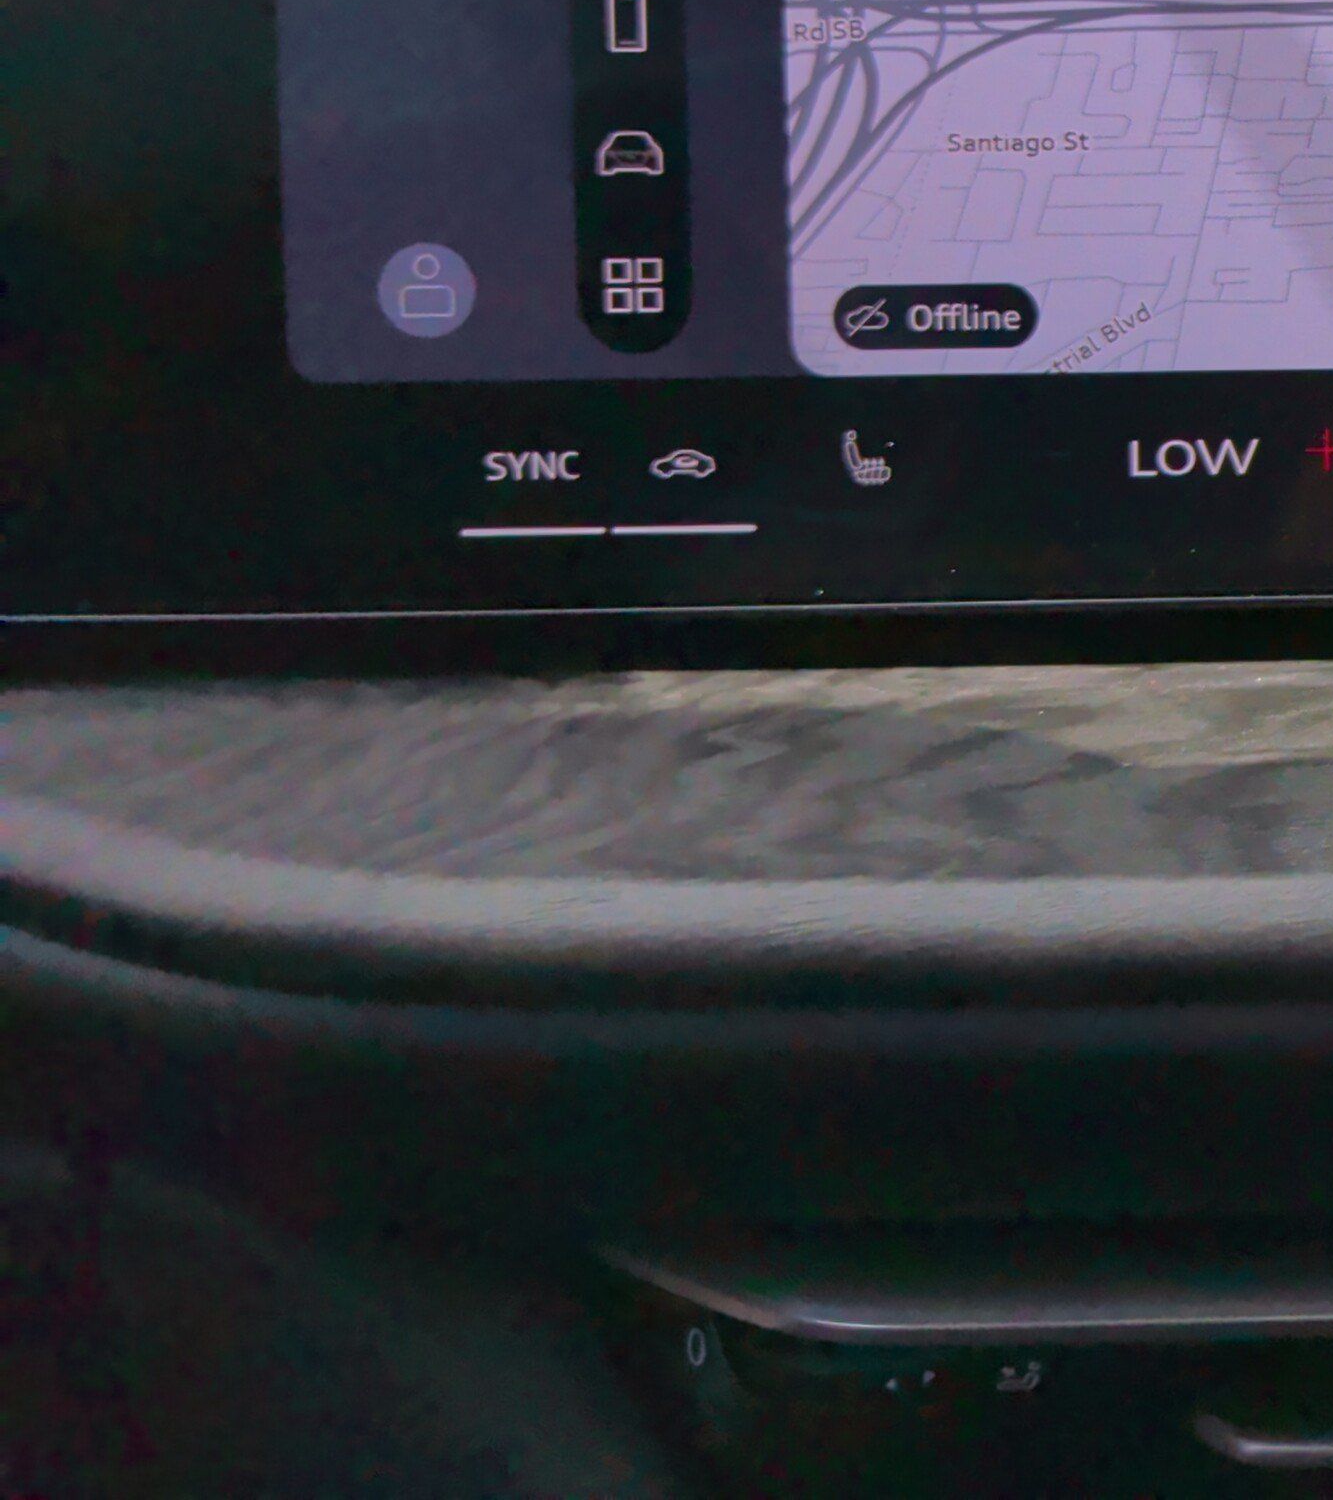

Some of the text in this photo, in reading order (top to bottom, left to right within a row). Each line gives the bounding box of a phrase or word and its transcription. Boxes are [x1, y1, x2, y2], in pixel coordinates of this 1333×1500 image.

[793, 20, 865, 41] Rd SB
[947, 133, 1090, 156] Santiago St
[906, 304, 1022, 332] Offline
[1101, 302, 1151, 343] Blvd
[484, 451, 580, 481] SYNC
[1128, 438, 1259, 478] LOW
